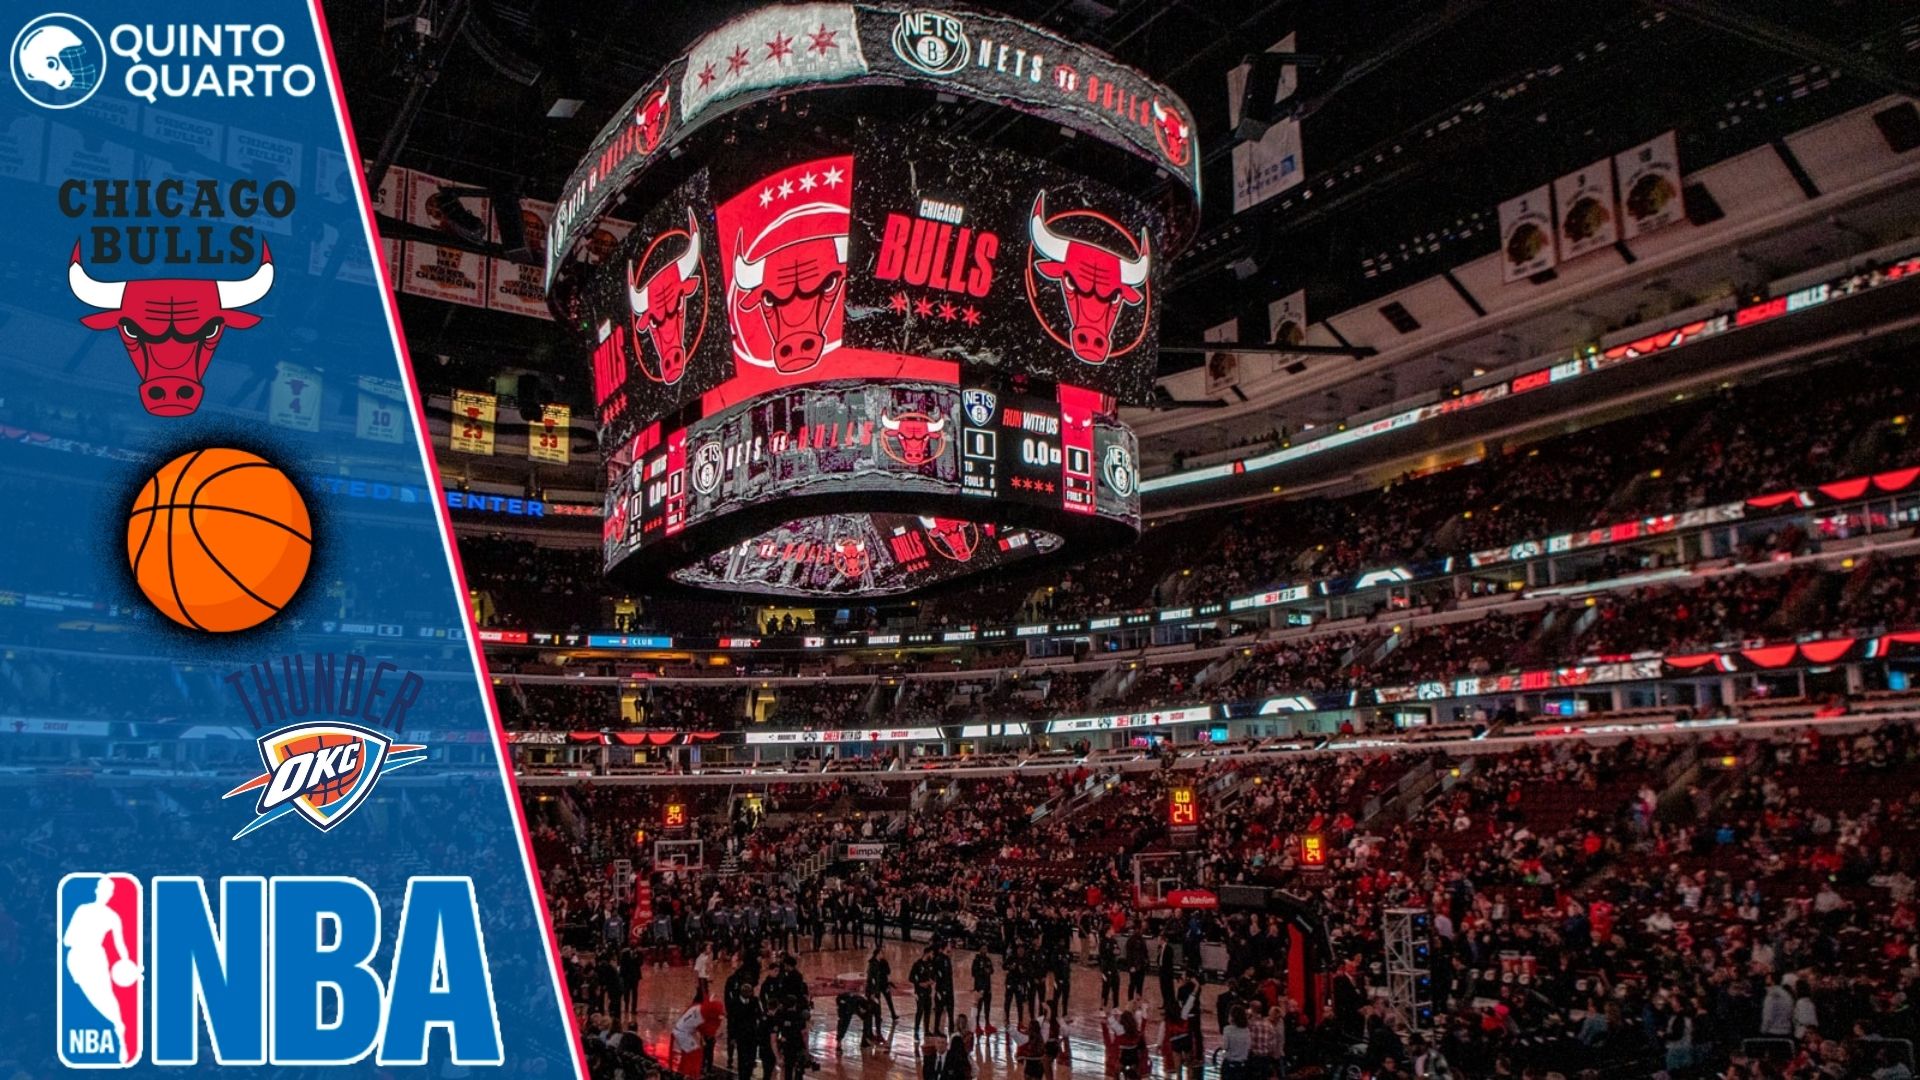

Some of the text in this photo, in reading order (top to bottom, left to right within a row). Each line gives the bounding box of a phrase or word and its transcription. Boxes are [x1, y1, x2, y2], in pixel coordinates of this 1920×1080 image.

[904, 13, 960, 43] NETS
[978, 39, 1149, 127] NETS VS BULLS
[919, 199, 963, 224] CHICAGO
[875, 213, 998, 298] BULLS
[416, 271, 476, 290] CHAMPIONS
[499, 286, 547, 301] CHAMPIO
[289, 397, 301, 414] 4
[964, 391, 993, 409] NETS
[371, 410, 391, 427] 10
[1003, 407, 1058, 435] RUN WITH US
[463, 423, 483, 440] 23
[538, 432, 558, 449] 33
[726, 436, 762, 471] NETS
[798, 420, 874, 451] BULLS
[975, 433, 984, 455] 0
[1022, 438, 1048, 465] 0.0
[964, 475, 984, 488] FOULS
[446, 492, 545, 518] ENTER
[632, 637, 653, 646] CLUB
[666, 812, 683, 825] 24
[1174, 803, 1193, 823] 24
[1306, 848, 1321, 862] 24
